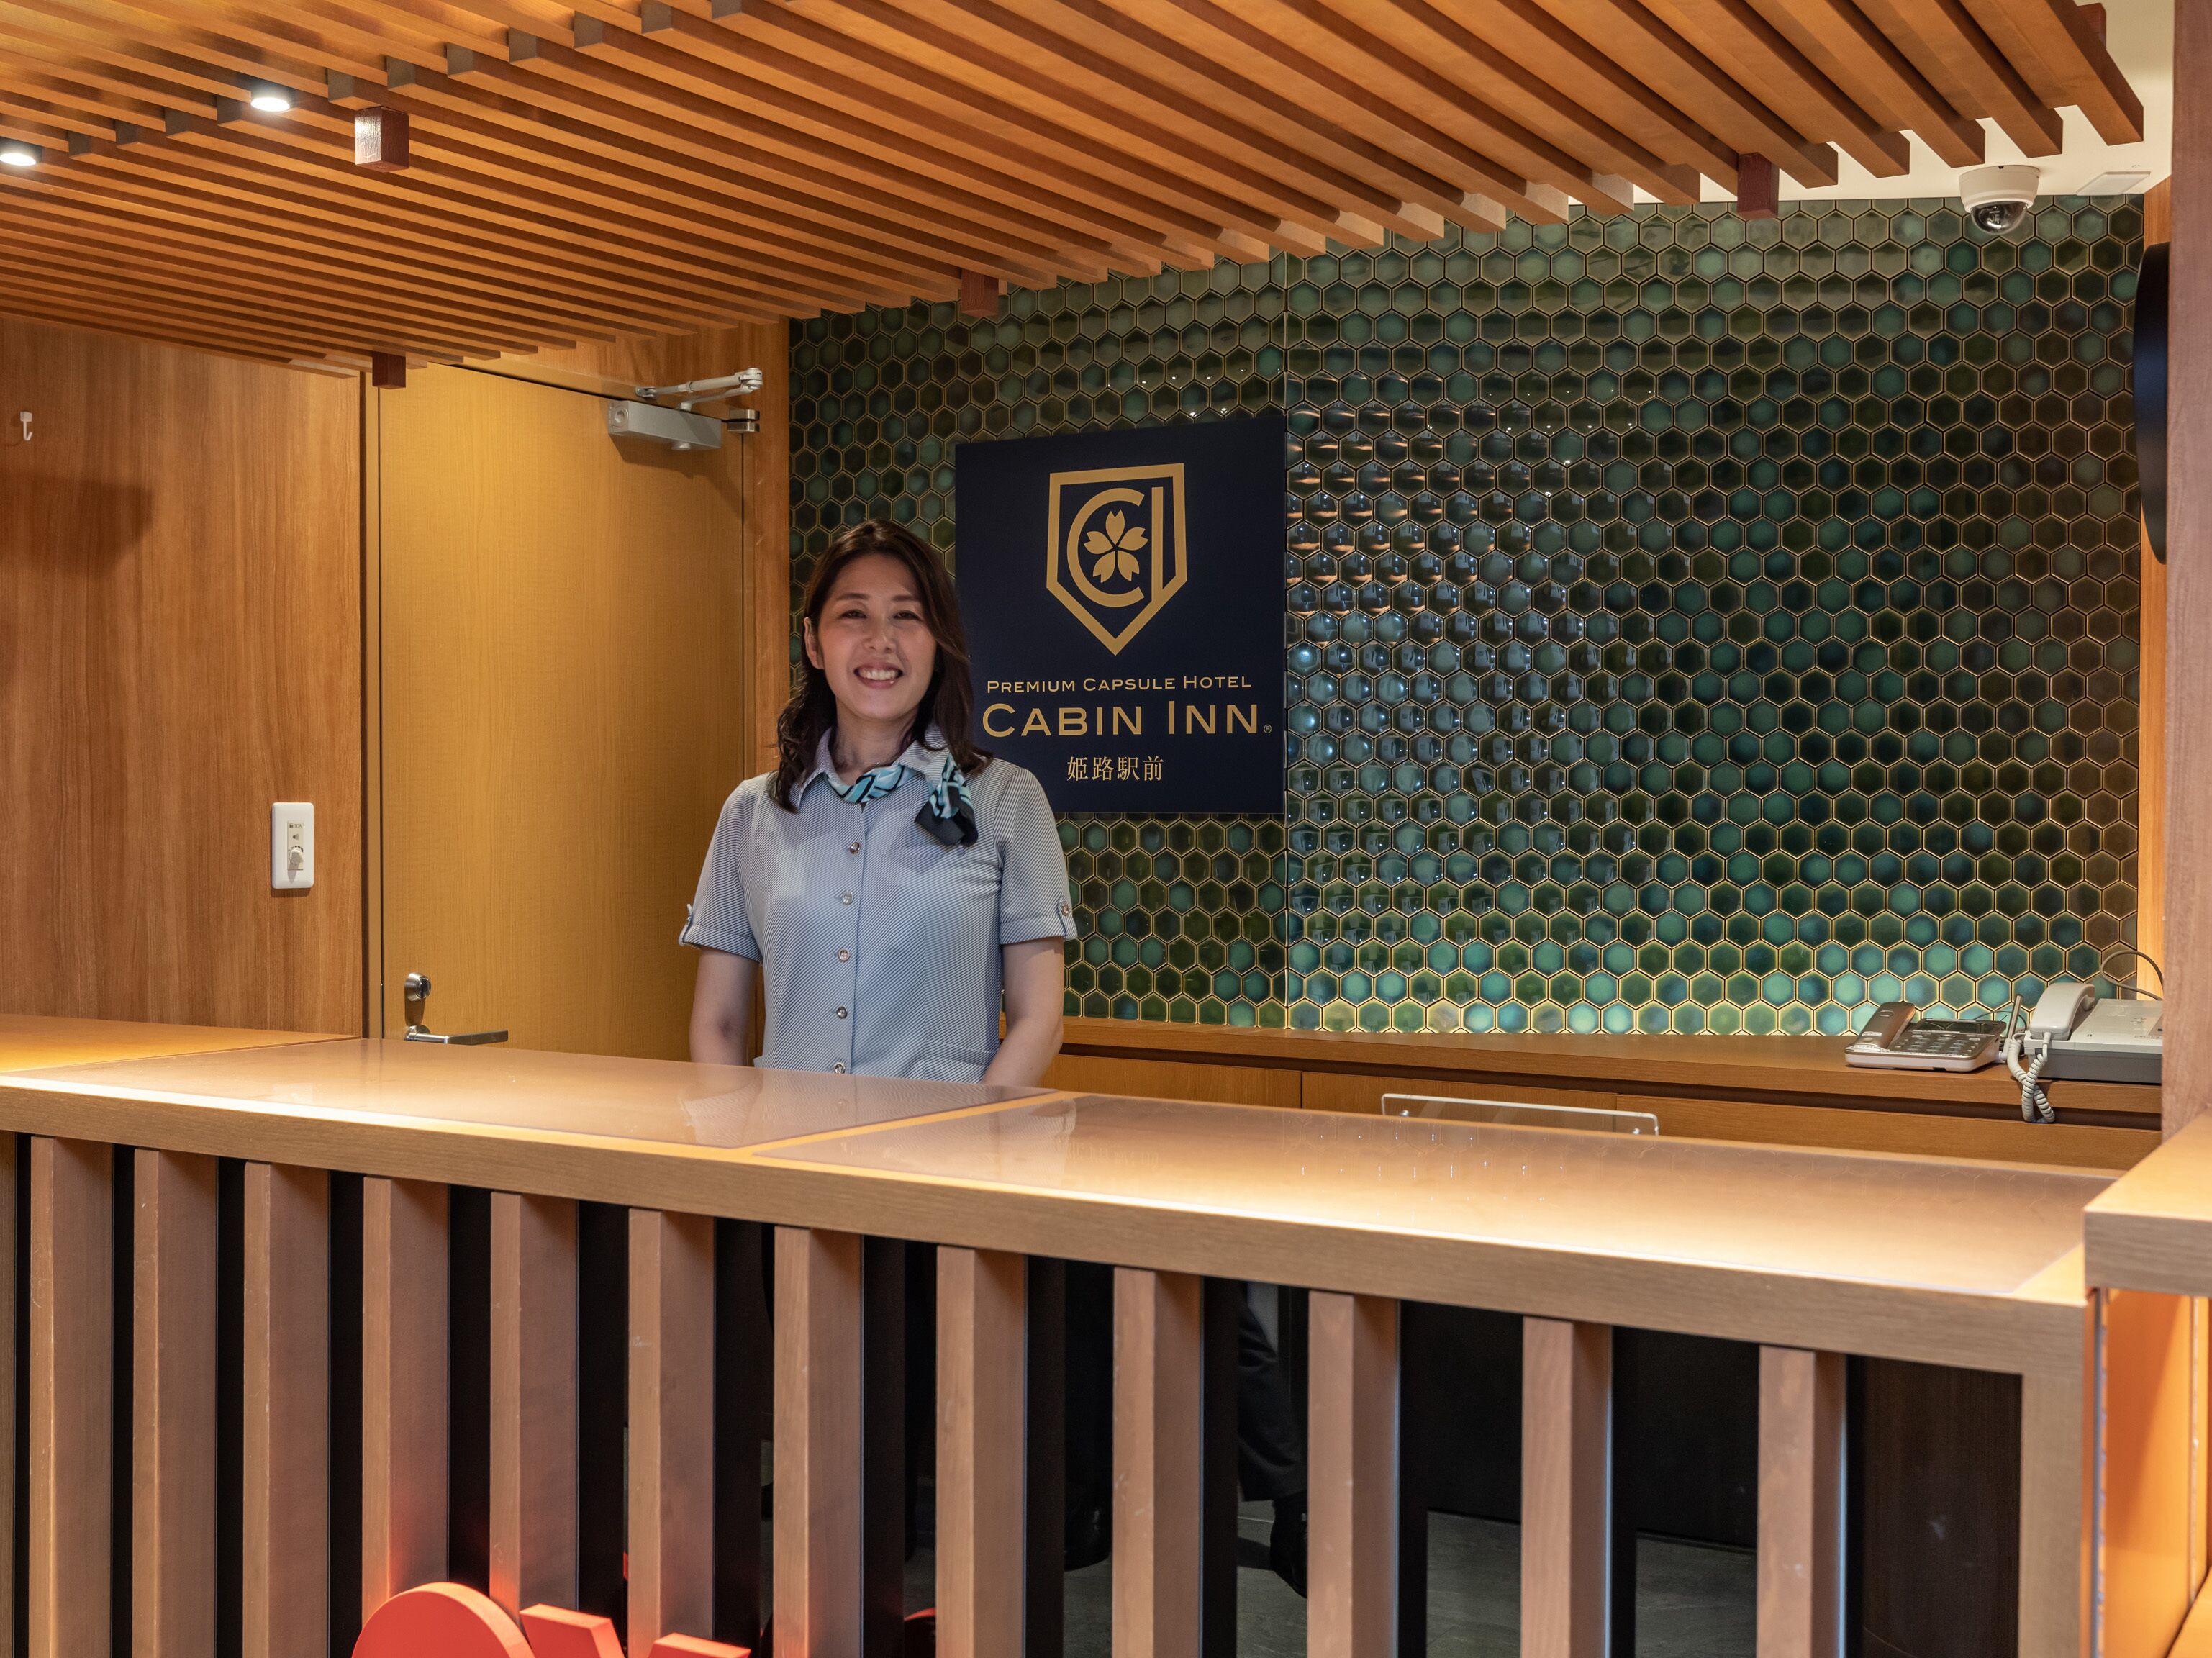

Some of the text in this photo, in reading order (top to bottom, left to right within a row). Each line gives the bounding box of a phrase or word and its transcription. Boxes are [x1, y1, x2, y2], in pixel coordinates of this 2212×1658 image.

[987, 675, 1252, 693] PREMIUM CAPSULE HOTEL
[982, 702, 1143, 738] CABIN
[1066, 756, 1165, 782] 姫路駅前
